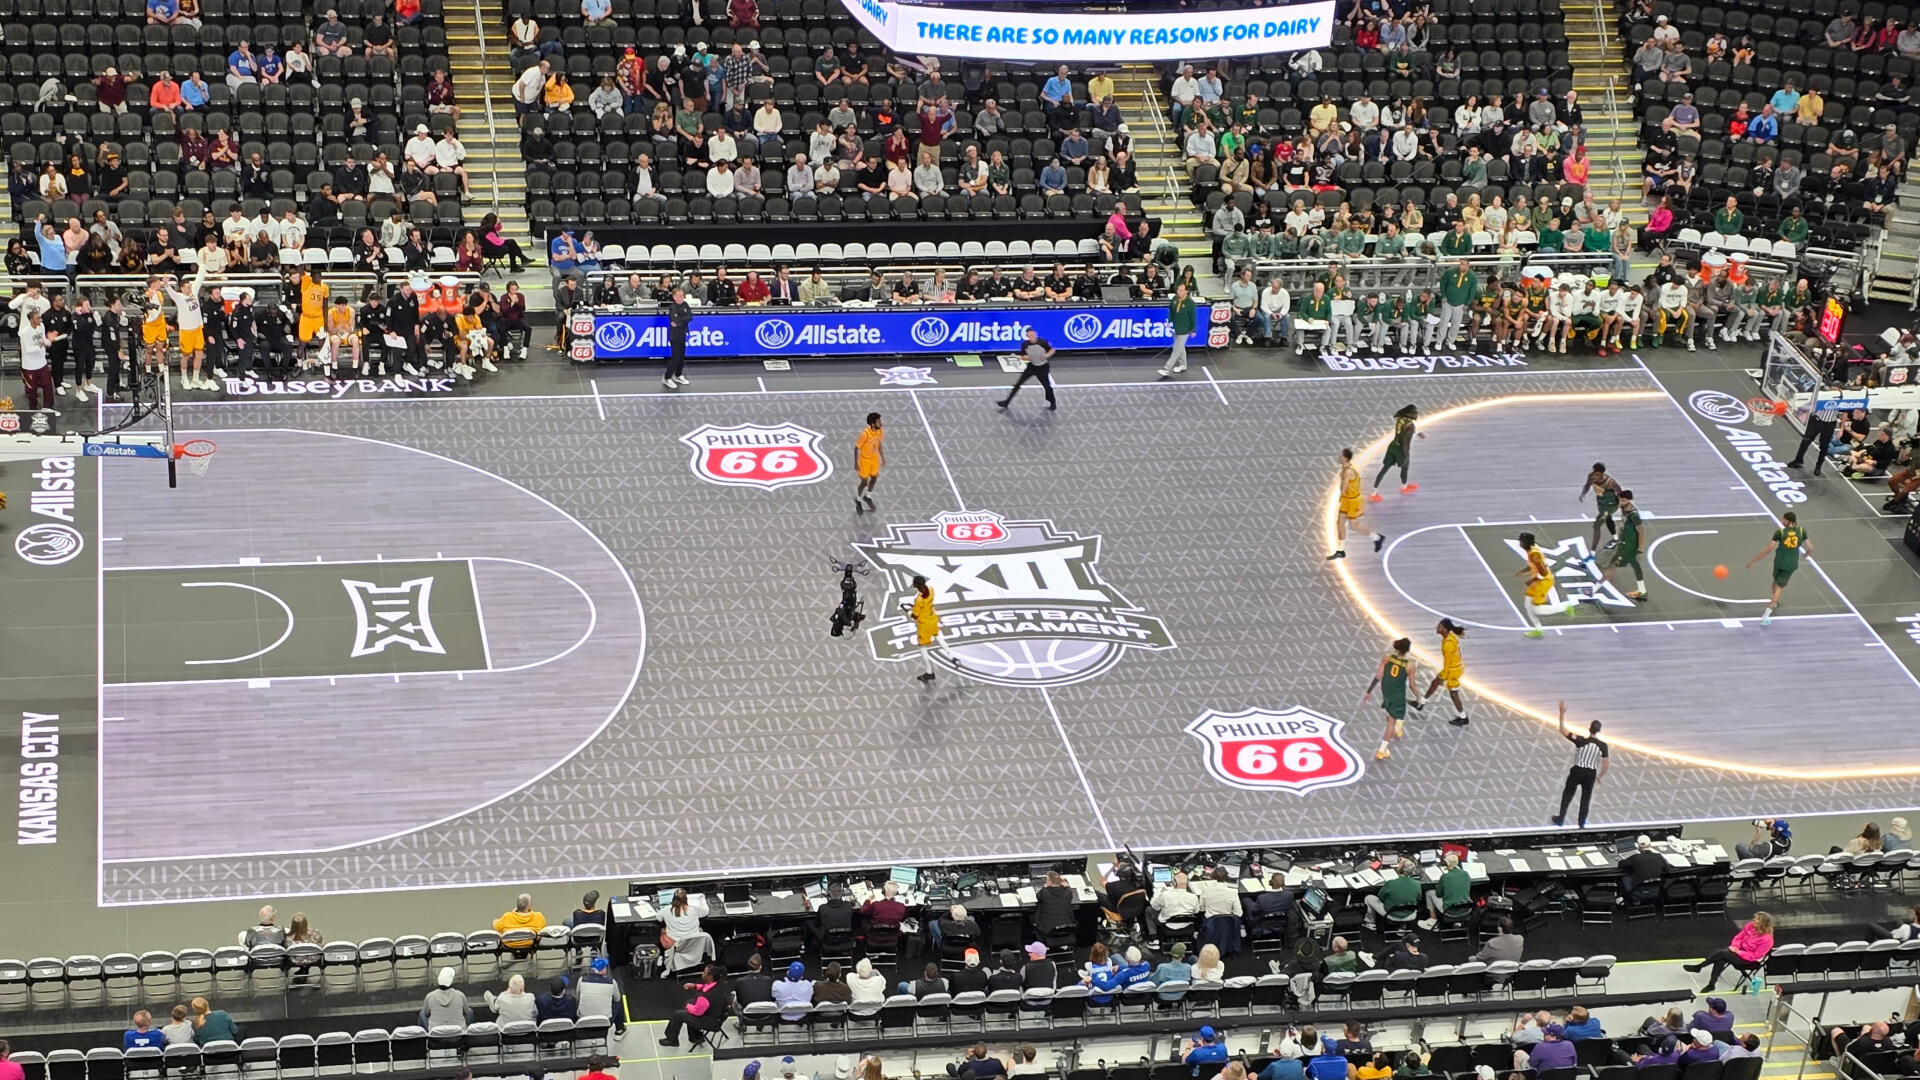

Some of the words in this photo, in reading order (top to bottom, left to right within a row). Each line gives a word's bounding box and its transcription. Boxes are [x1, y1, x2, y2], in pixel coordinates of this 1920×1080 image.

[917, 21, 983, 42] THERE
[986, 26, 1029, 44] ARE
[1031, 28, 1059, 45] SO
[1063, 28, 1126, 45] MANY
[1129, 25, 1219, 45] REASONS
[1223, 23, 1260, 41] FOR
[1264, 16, 1321, 38] DAIRY
[574, 321, 592, 332] 66
[1101, 317, 1176, 339] Allstat
[574, 346, 592, 357] 66
[2, 420, 17, 429] 66
[706, 433, 801, 446] PHILLIPS
[103, 446, 137, 456] Allstate
[720, 449, 800, 475] 66
[943, 514, 994, 524] PHILLIPS
[952, 524, 995, 539] 66
[1783, 535, 1799, 549] 43
[875, 544, 1112, 608] XII
[891, 609, 1141, 636] BSKETBALL
[1390, 664, 1400, 678] 0
[21, 711, 60, 759] CITY
[1212, 719, 1320, 738] PHILLIPS
[1236, 741, 1324, 775] 66
[17, 762, 59, 845] KANSAS
